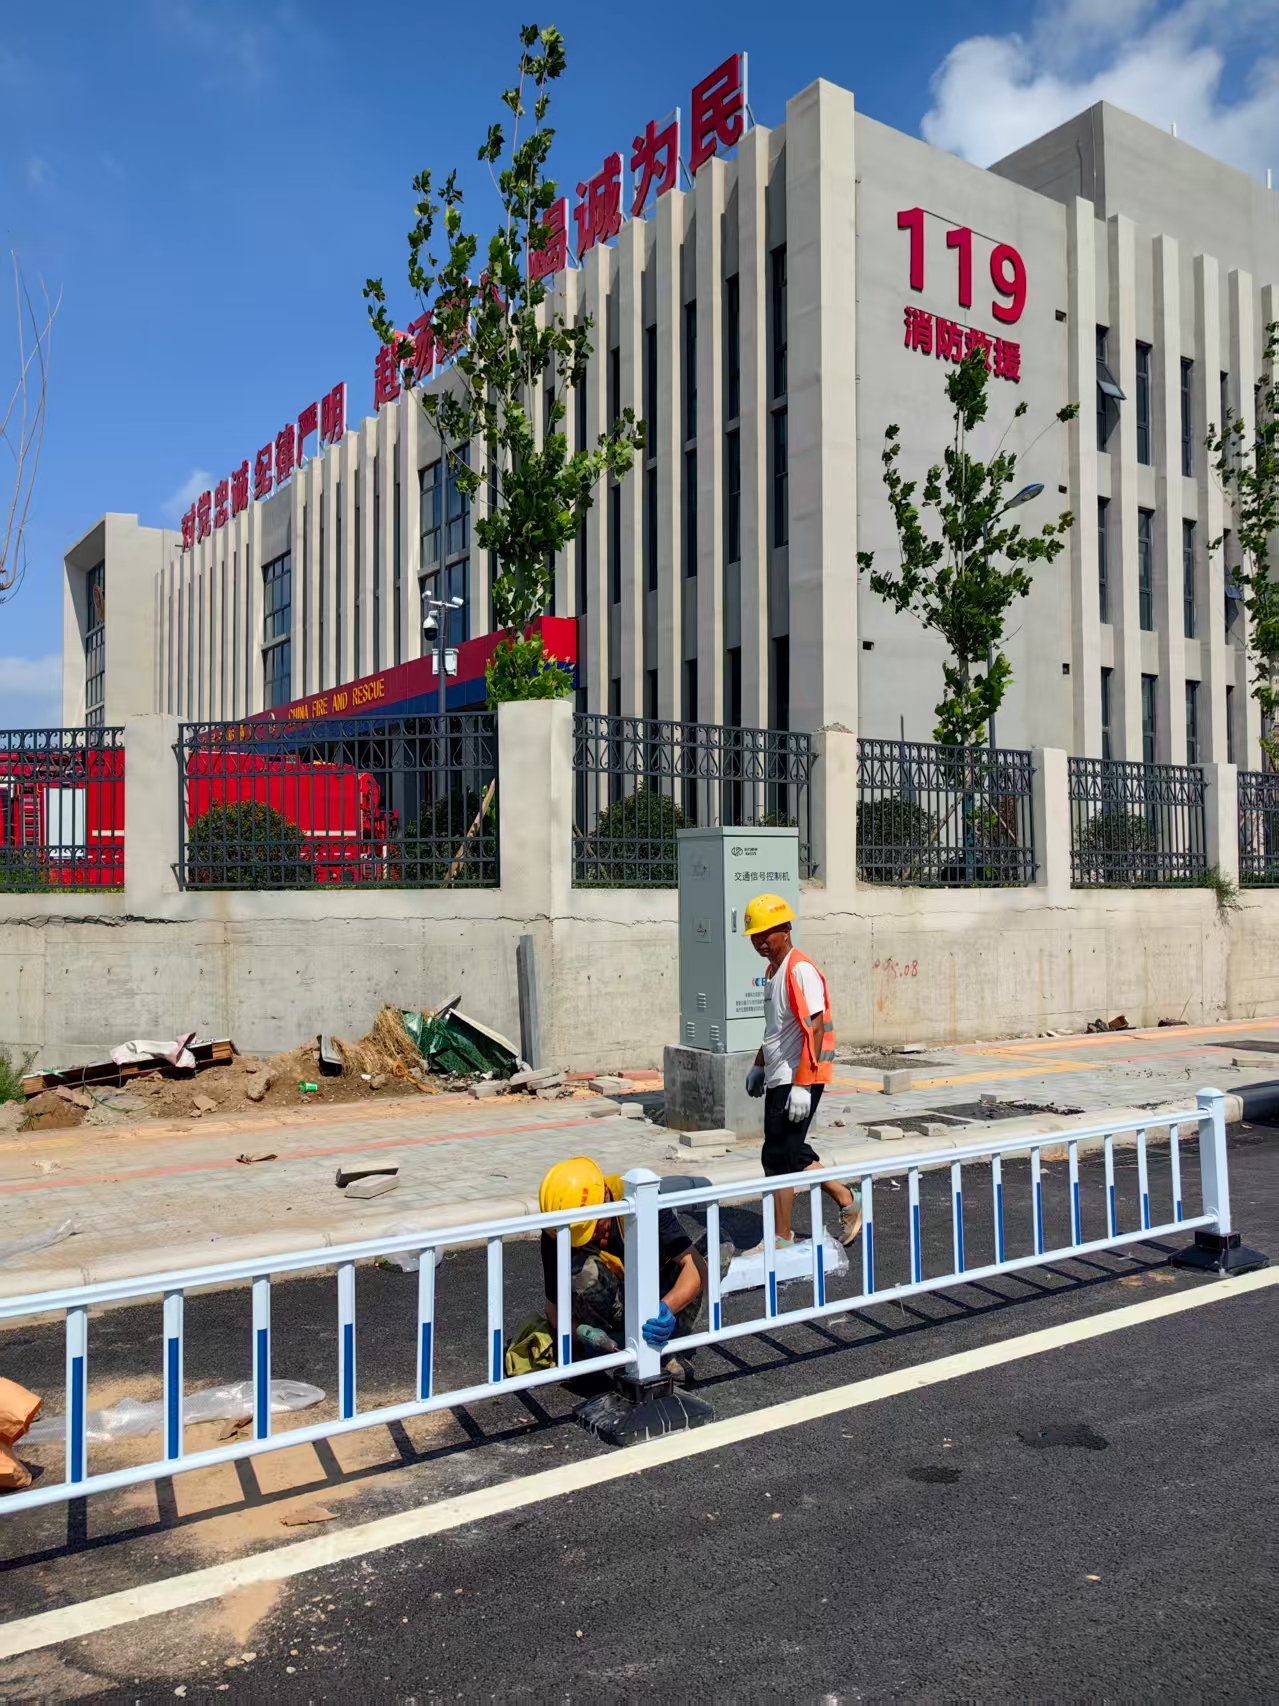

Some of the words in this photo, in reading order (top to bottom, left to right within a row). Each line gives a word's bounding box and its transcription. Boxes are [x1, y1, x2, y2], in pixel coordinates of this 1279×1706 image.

[897, 207, 1026, 326] 119
[904, 306, 1021, 384] 消防救援
[254, 382, 345, 500] 纪律严明
[289, 704, 309, 719] CHINA
[312, 697, 328, 717] FIRE
[332, 691, 348, 713] AND
[352, 678, 385, 705] RESCUE
[734, 870, 791, 882] 交通信号控制机
